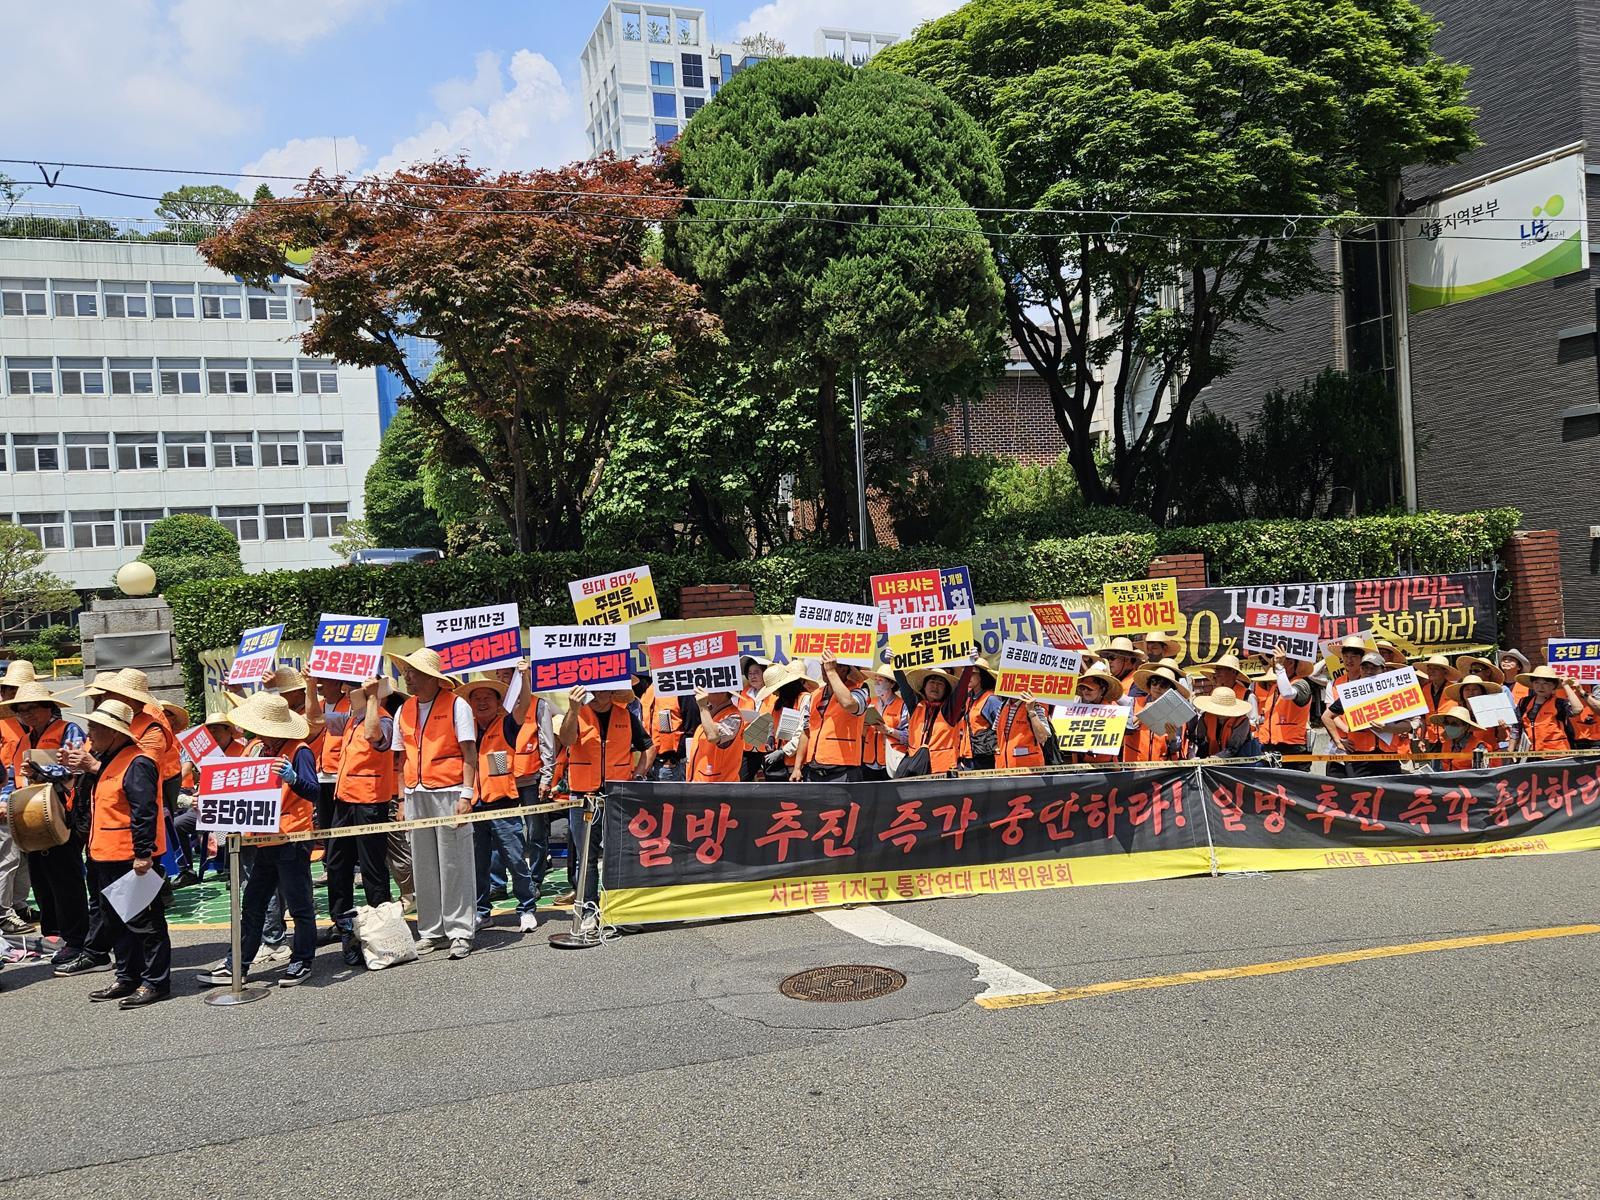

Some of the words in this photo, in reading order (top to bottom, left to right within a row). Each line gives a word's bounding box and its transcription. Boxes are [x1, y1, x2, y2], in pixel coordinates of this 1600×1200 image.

[1418, 199, 1500, 238] 서울지역본부
[1520, 219, 1544, 239] LH
[582, 579, 606, 595] 임대
[610, 572, 639, 588] 80%
[878, 578, 934, 595] LH공사는
[1111, 587, 1129, 595] 주민
[1131, 584, 1149, 593] 동의
[1151, 582, 1169, 591] 없는
[595, 587, 634, 610] 주민은
[1117, 593, 1144, 603] 신도시
[1146, 591, 1164, 601] 개발
[1355, 576, 1464, 615] 말아먹는
[624, 596, 655, 619] 가나!
[799, 605, 831, 622] 공공임대
[834, 610, 854, 625] 80%
[855, 613, 874, 627] 전면
[1109, 600, 1176, 629] 철회하라
[436, 612, 504, 633] 주민재산권
[900, 616, 924, 630] 임대
[929, 614, 958, 627] 80%
[1255, 613, 1309, 629] 졸속행정
[1366, 607, 1477, 644] 철회하라
[321, 624, 351, 643] 주민
[350, 623, 381, 641] 희생
[544, 632, 617, 648] 주민재산권
[794, 632, 872, 654] 재검토하라
[910, 628, 951, 648] 주민은
[1247, 630, 1313, 658] 중단하라!
[437, 630, 518, 672] 보장하라!
[662, 635, 723, 665] 졸속행정
[893, 648, 934, 669] 어디로
[938, 641, 971, 660] 가나!
[1006, 646, 1038, 664] 공공임대
[1040, 653, 1058, 667] 80%
[1060, 656, 1076, 671] 전면
[1554, 645, 1582, 659] 주민
[1585, 645, 1600, 657] 희
[230, 657, 271, 679] 강요말라!
[311, 649, 377, 676] 강요말라!
[536, 652, 627, 689] 보장하라!
[1551, 664, 1600, 680] 강요말
[656, 665, 738, 692] 중단하라!
[999, 672, 1074, 695] 재검토하라
[1343, 682, 1374, 700] 공공임대
[1375, 678, 1395, 691] 80%
[1395, 673, 1412, 686] 전면
[1090, 707, 1117, 718] 80%
[1349, 687, 1421, 727] 재검토하라
[1069, 719, 1106, 732] 주민은
[1091, 733, 1120, 746] 가나!
[210, 763, 271, 791] 졸속행정
[201, 799, 276, 826] 중단하라!
[1211, 783, 1297, 833] 일방
[1305, 784, 1386, 834] 추진
[1399, 784, 1478, 836] 즉각
[628, 803, 739, 868] 일방
[754, 801, 861, 863] 추진
[878, 798, 978, 853] 즉각
[989, 780, 1187, 846] 중단하라!
[768, 880, 830, 907] 서리풀
[838, 877, 889, 901] 1지구
[896, 871, 973, 897] 통합연대
[980, 863, 1074, 890] 대책위원회
